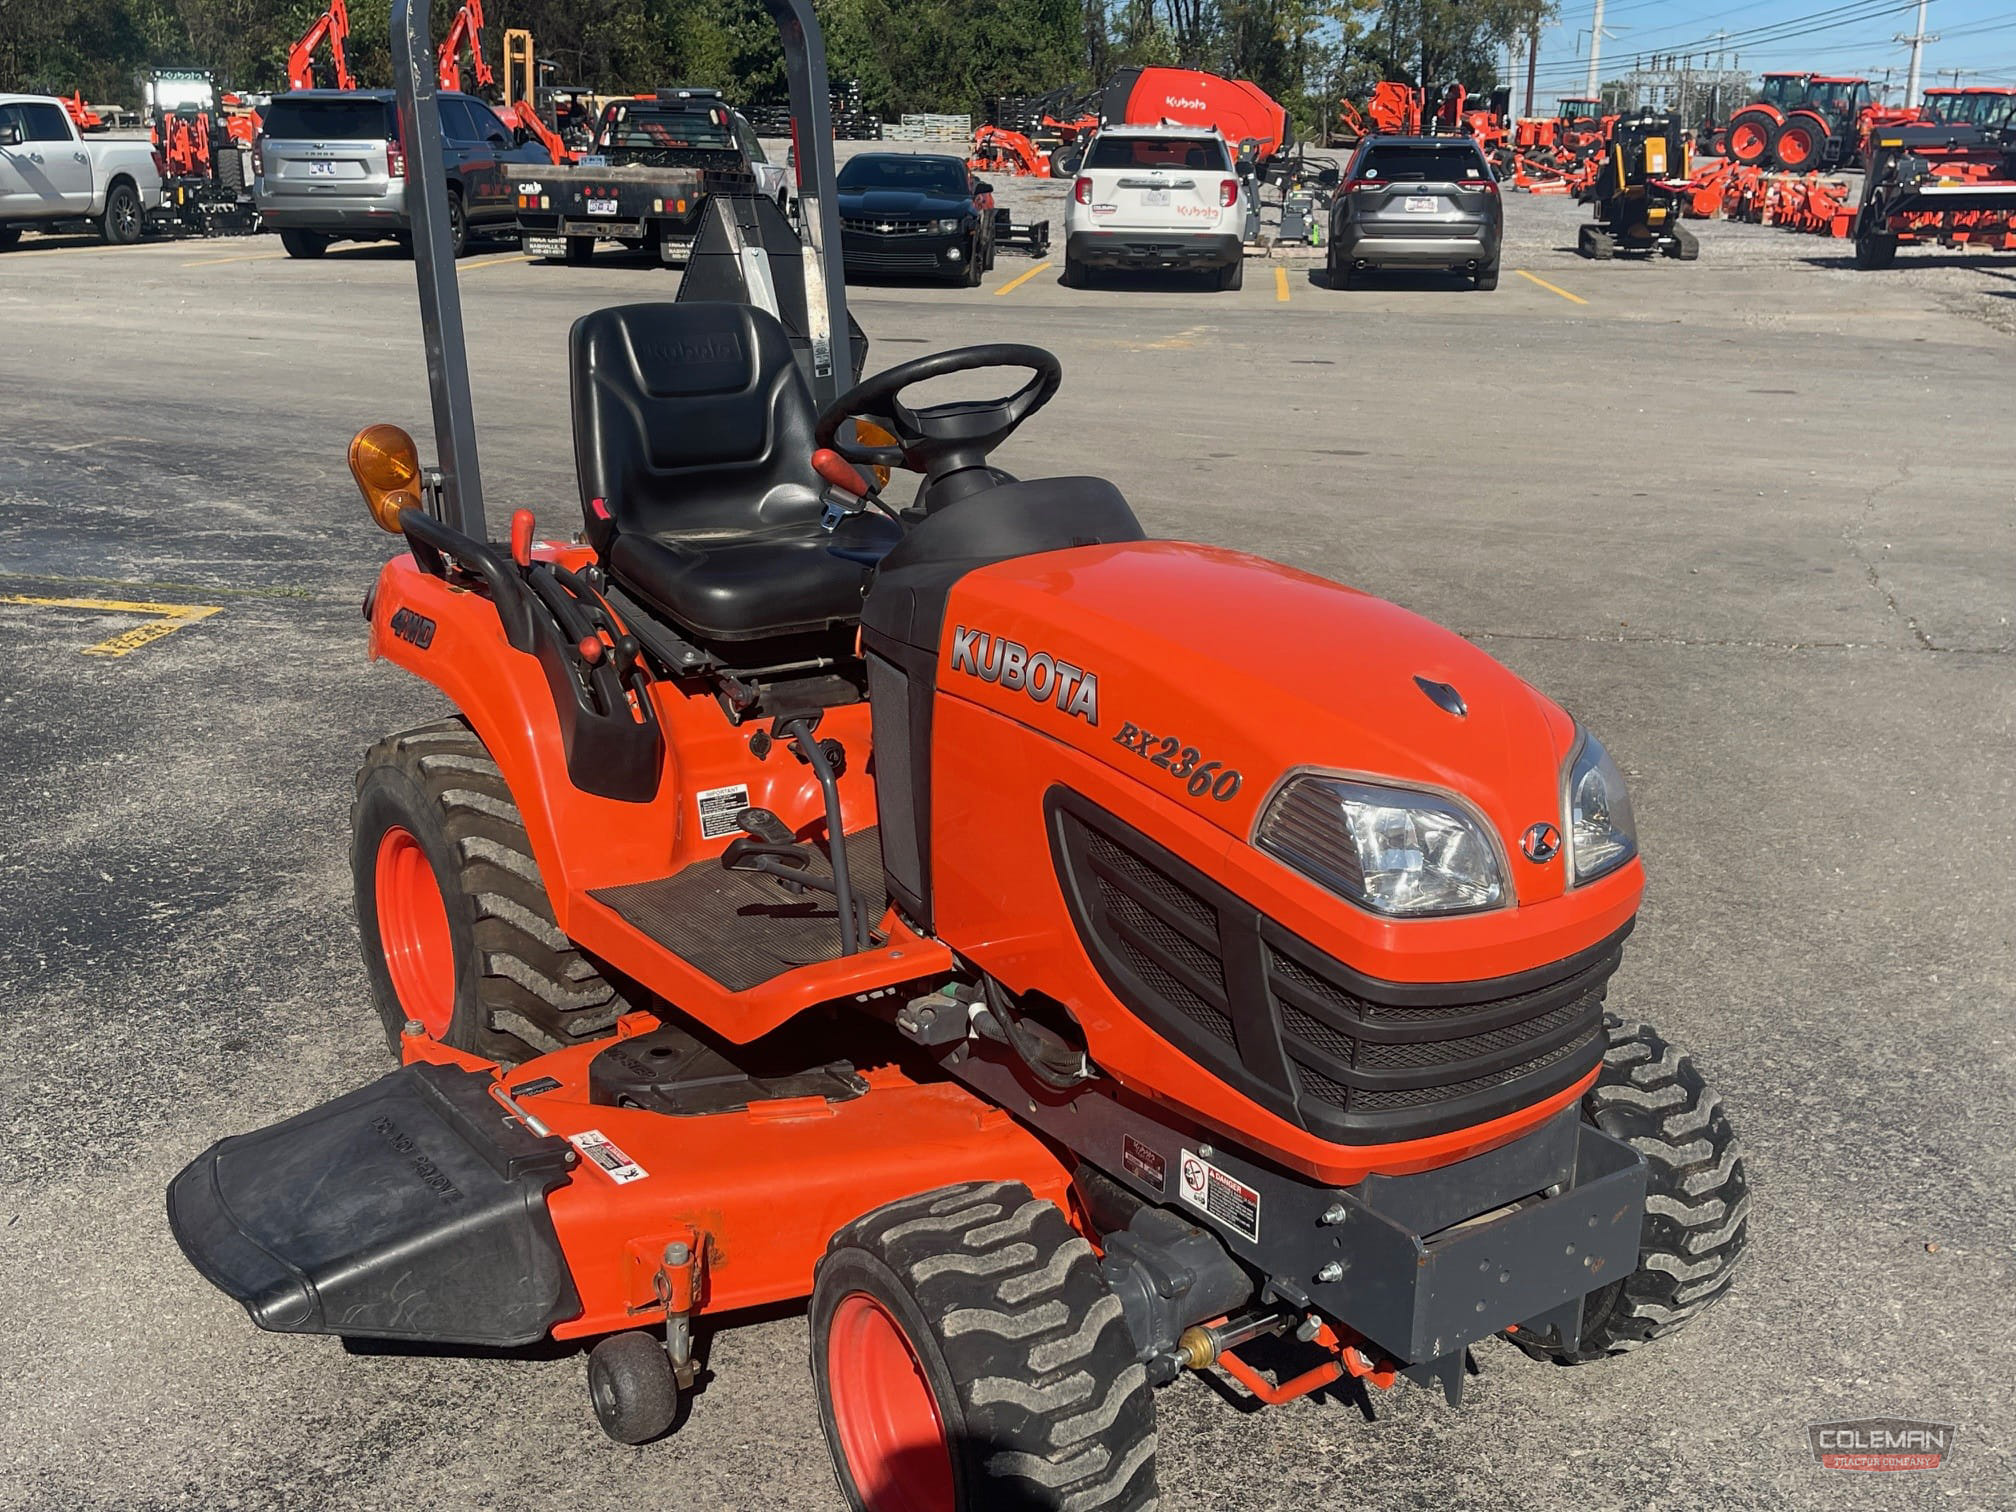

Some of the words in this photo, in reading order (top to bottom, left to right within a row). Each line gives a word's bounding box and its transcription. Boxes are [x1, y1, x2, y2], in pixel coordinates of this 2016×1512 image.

[1165, 95, 1207, 110] Kubota
[1177, 205, 1219, 217] Kubota
[390, 606, 436, 650] 4WD
[951, 625, 1099, 728] KUBOTA
[1112, 720, 1243, 802] BX2360
[1214, 1171, 1242, 1194] DANGER
